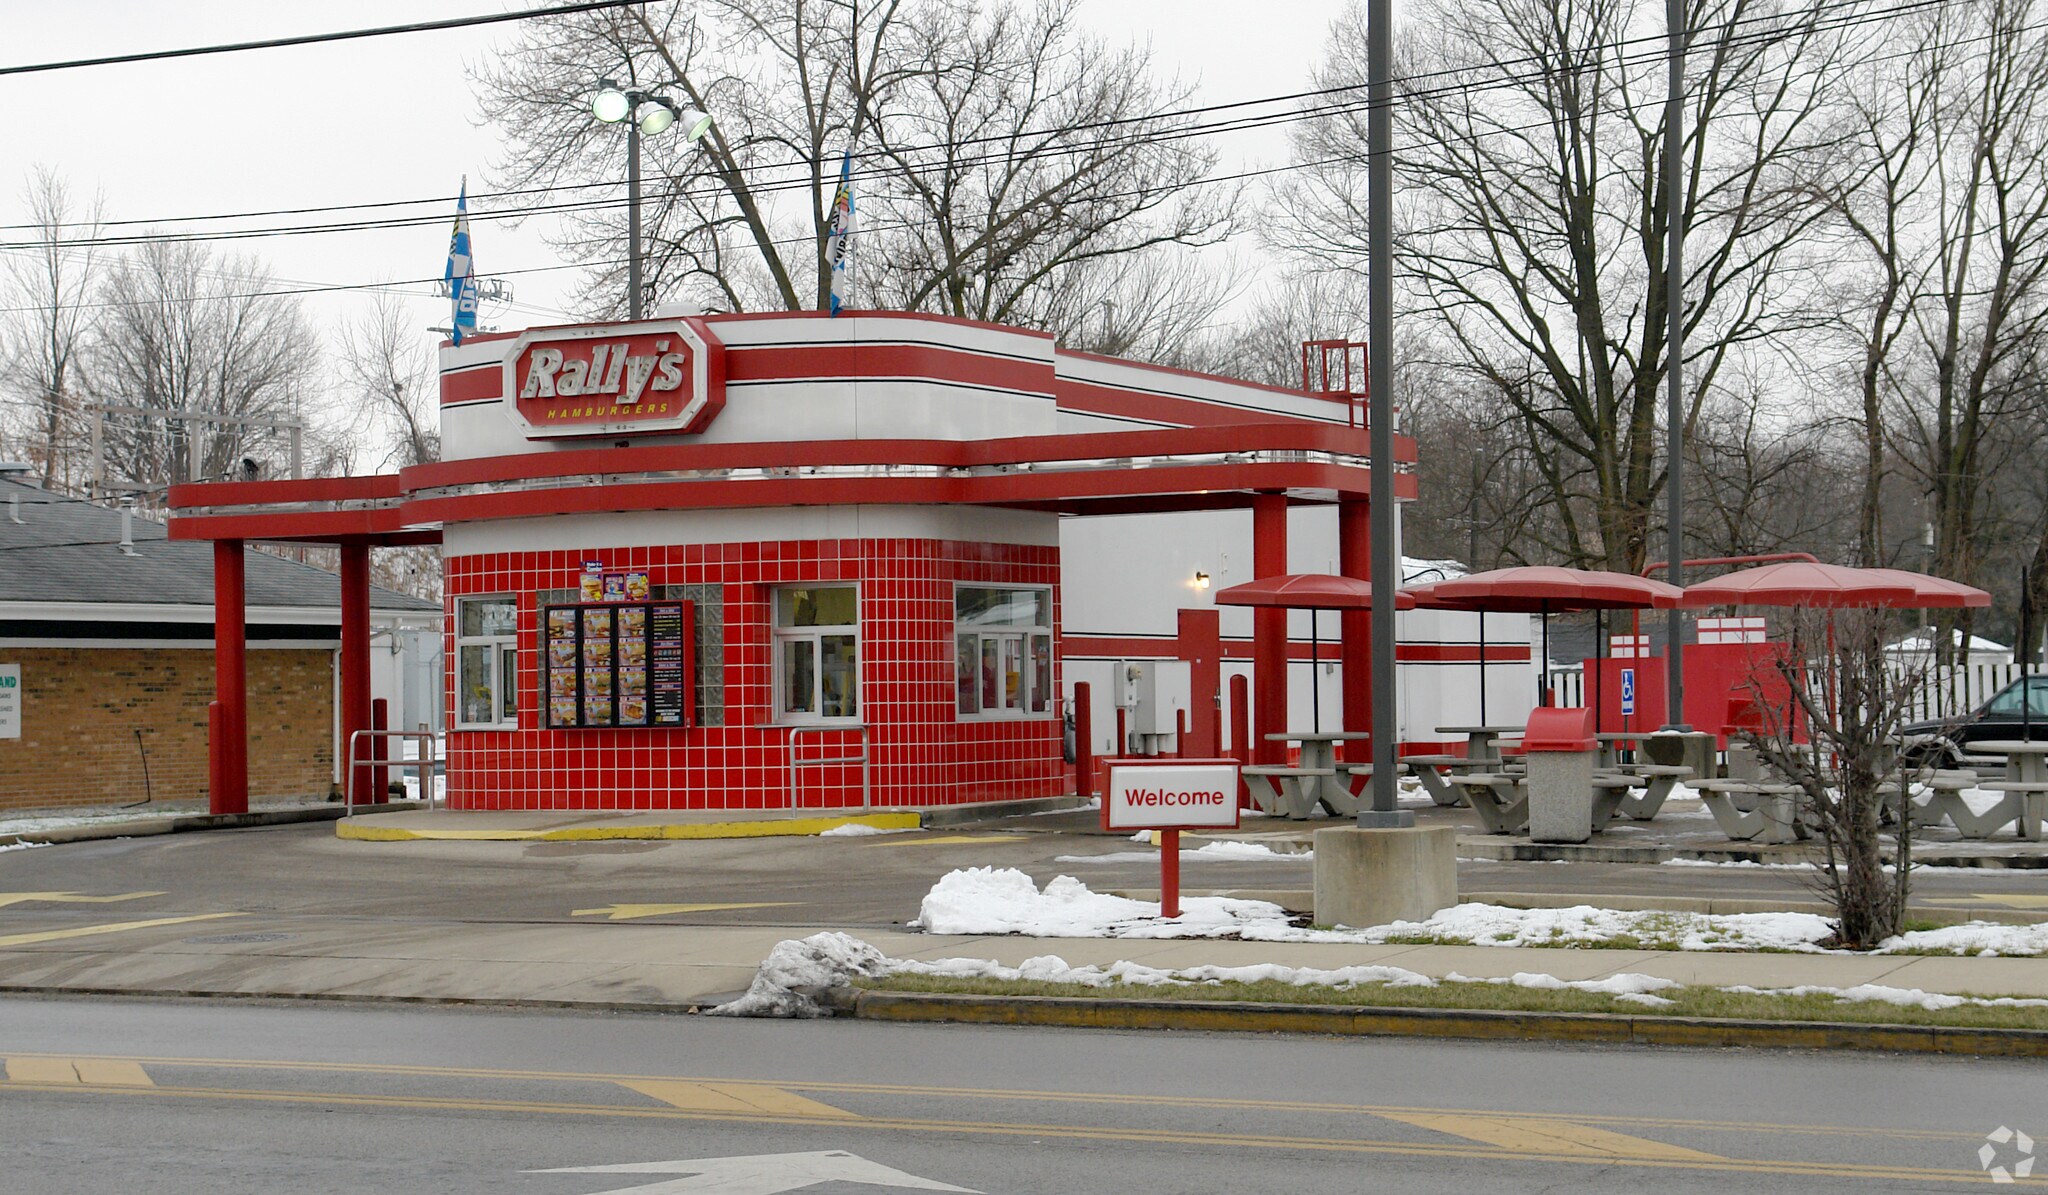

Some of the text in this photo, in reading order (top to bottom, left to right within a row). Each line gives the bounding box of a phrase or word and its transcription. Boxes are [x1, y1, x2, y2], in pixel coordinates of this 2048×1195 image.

[520, 340, 684, 404] Rally's
[548, 403, 668, 419] HAMBURGERS
[1125, 788, 1224, 806] Welcome
